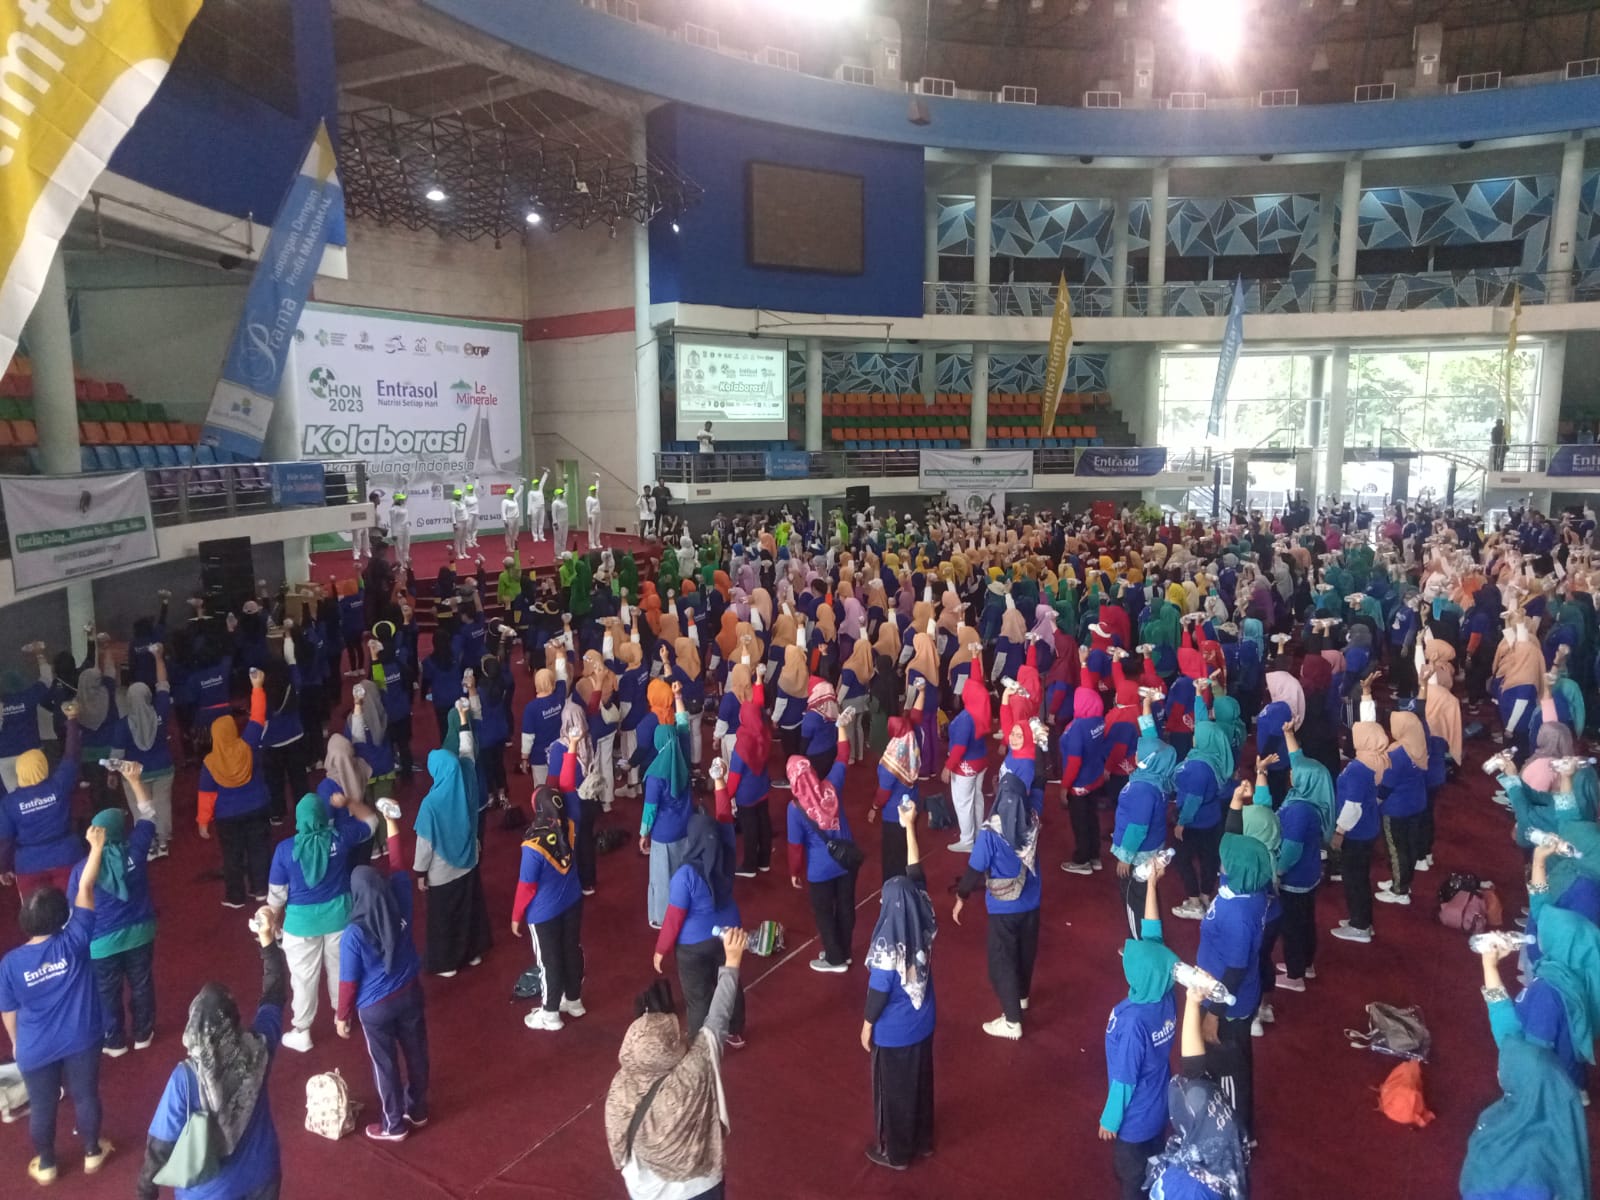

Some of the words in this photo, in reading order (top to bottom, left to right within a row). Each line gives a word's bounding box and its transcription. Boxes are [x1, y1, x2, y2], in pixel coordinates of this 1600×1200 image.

[291, 190, 318, 231] Dengan
[286, 255, 307, 286] Profit
[300, 198, 332, 257] MAKSIMAL
[328, 384, 362, 399] HON
[377, 379, 438, 399] Entrasol
[475, 381, 487, 395] Le
[719, 382, 767, 393] Kolaborasi
[329, 399, 364, 413] 2023
[377, 399, 401, 407] Nutrisi
[402, 399, 423, 409] Setiap
[424, 400, 438, 408] Hari
[456, 393, 498, 406] Minerale
[303, 423, 468, 455] Kolaborasi
[414, 460, 474, 472] Indonesia
[1094, 455, 1139, 467] Entrasol
[19, 793, 57, 811] Entrasol
[24, 957, 69, 982] Entrasol
